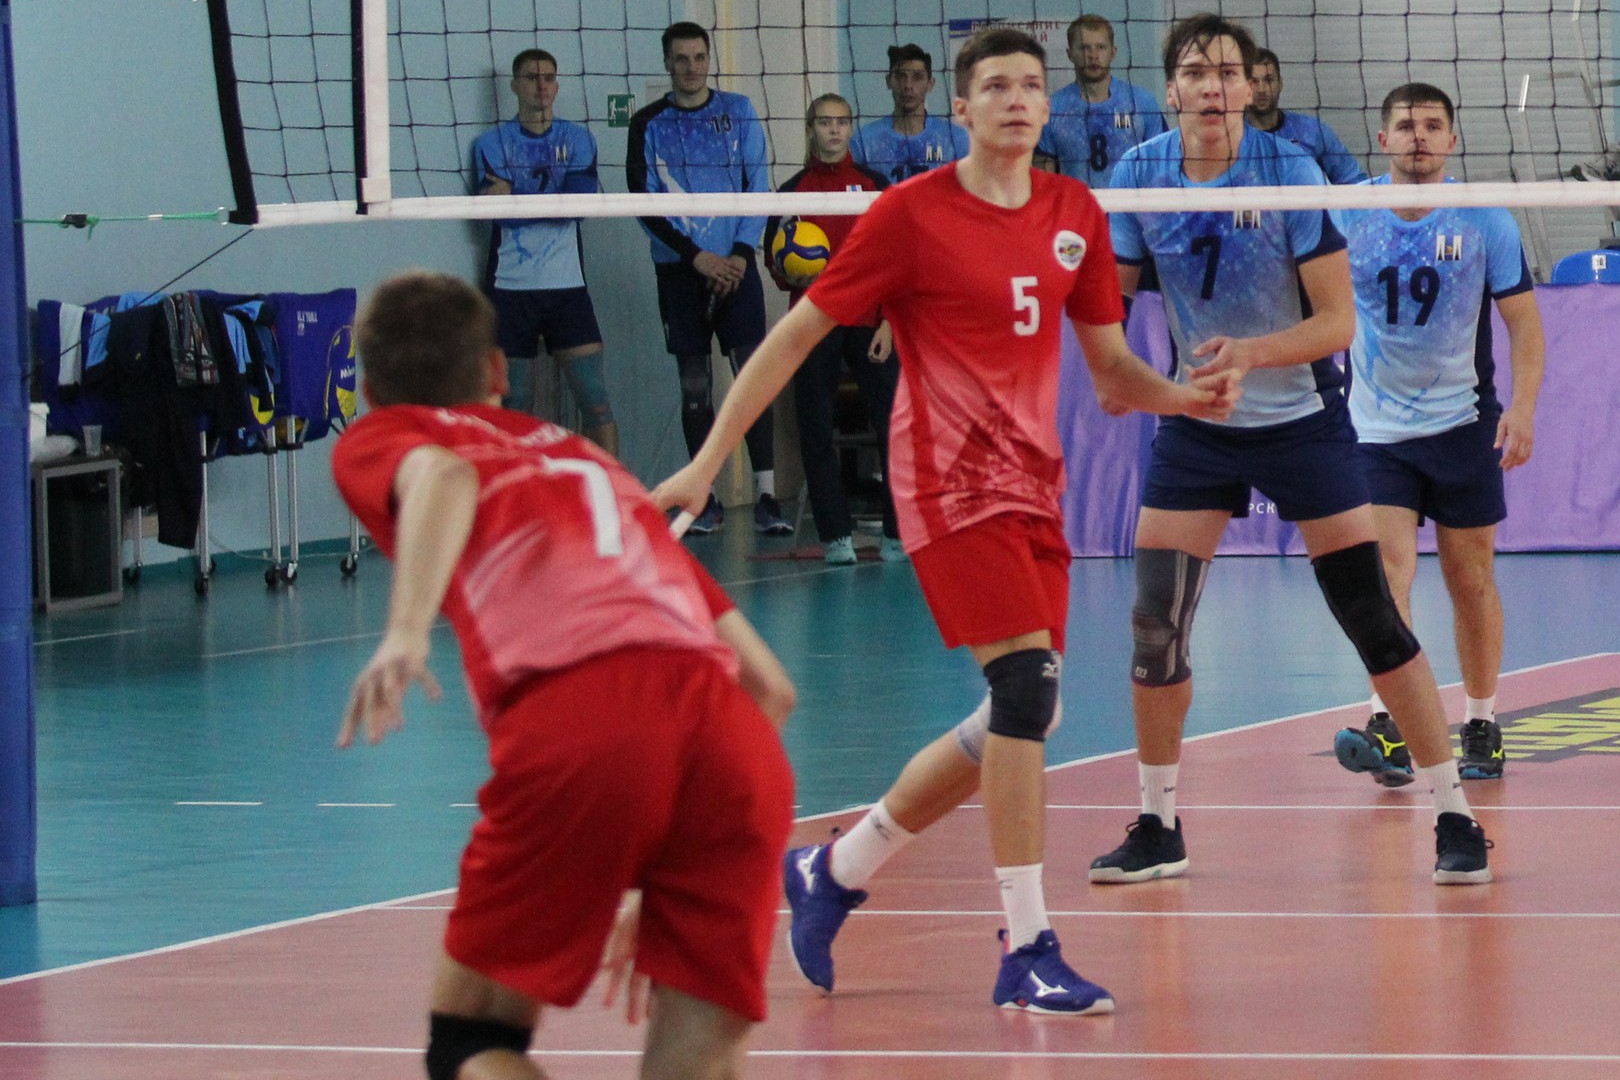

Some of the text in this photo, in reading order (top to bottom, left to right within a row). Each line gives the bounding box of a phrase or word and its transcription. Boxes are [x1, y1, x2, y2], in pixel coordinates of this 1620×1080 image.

[1090, 133, 1107, 171] 8
[1191, 234, 1222, 300] 7
[1377, 265, 1440, 326] 19
[1011, 276, 1040, 336] 5
[539, 453, 624, 557] 7
